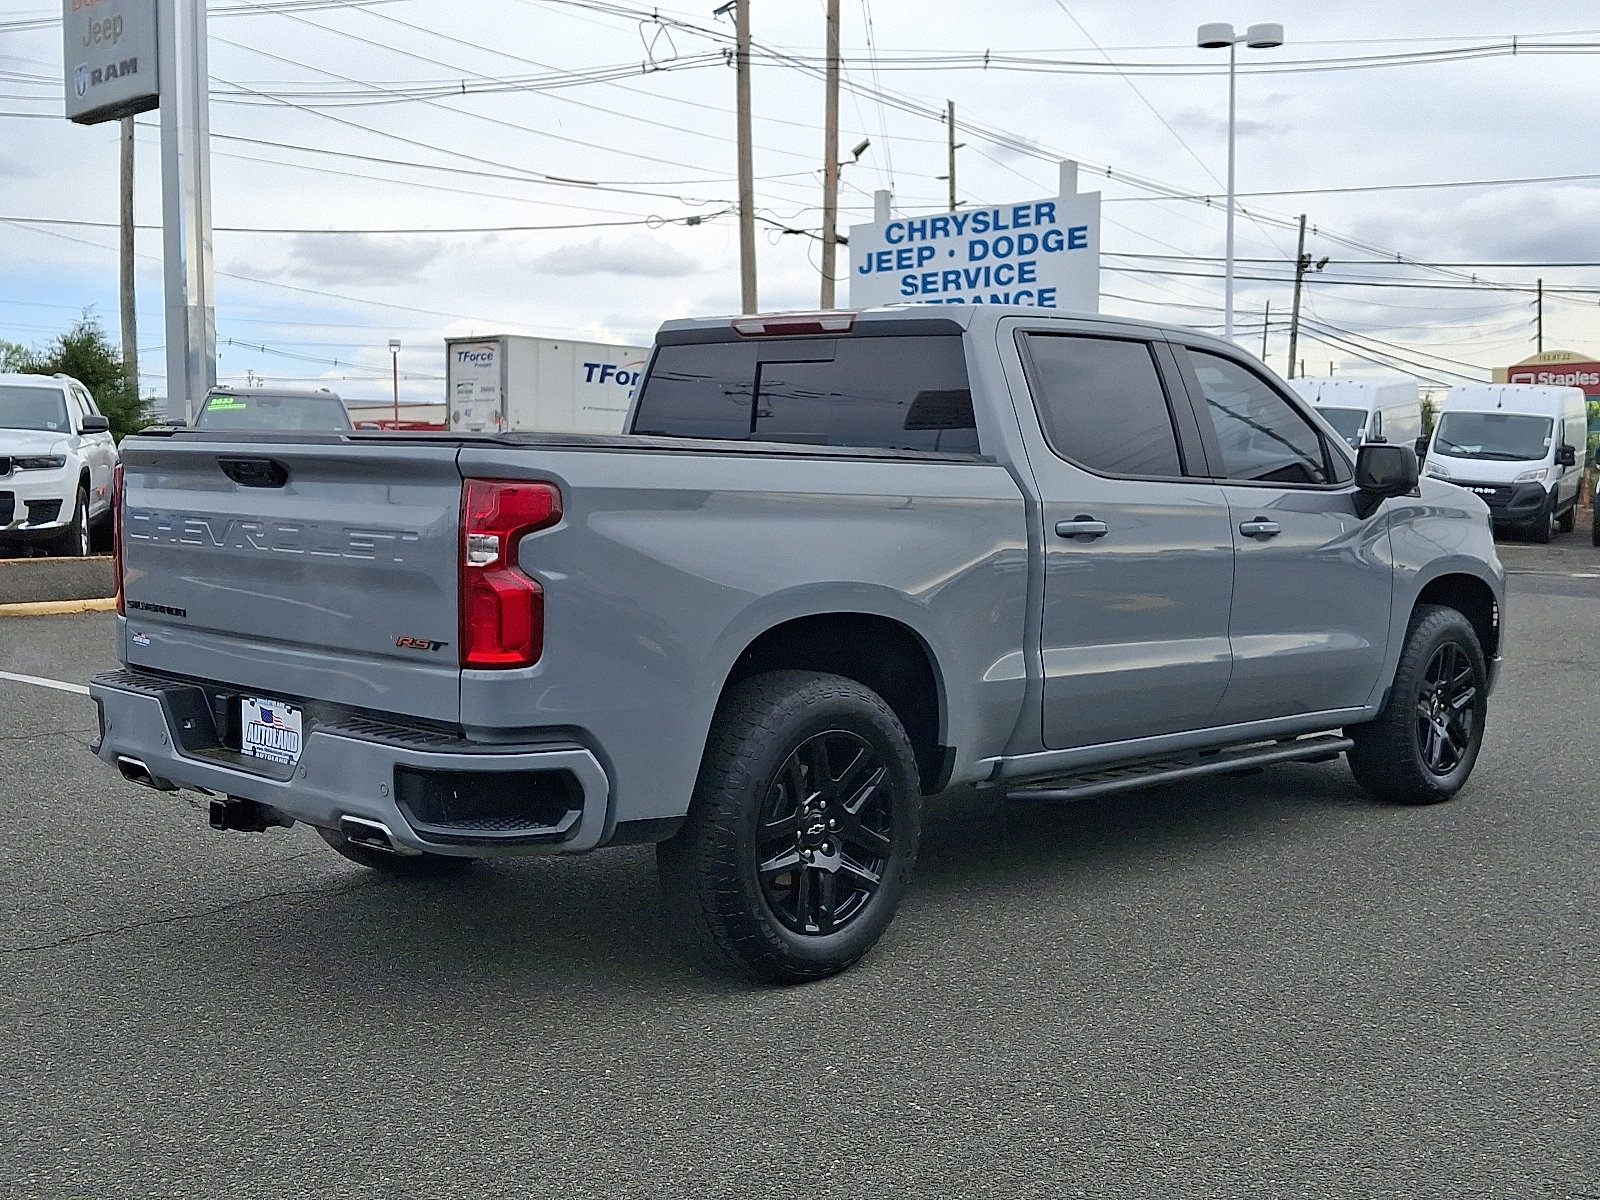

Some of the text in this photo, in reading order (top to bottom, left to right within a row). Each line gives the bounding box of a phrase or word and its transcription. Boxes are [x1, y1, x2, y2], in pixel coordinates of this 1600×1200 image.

[83, 14, 123, 47] Jeep
[91, 57, 138, 86] RAM
[885, 202, 1056, 244] CHRYSLER
[859, 226, 1088, 275] JEEP DODGE
[900, 261, 1037, 296] SERVICE
[457, 351, 494, 362] TForce
[1538, 371, 1600, 386] Staples
[129, 512, 420, 562] CHEVROLET
[396, 636, 449, 651] RST
[246, 721, 299, 753] AUTOLAND
[255, 751, 288, 765] AUTOLAND
